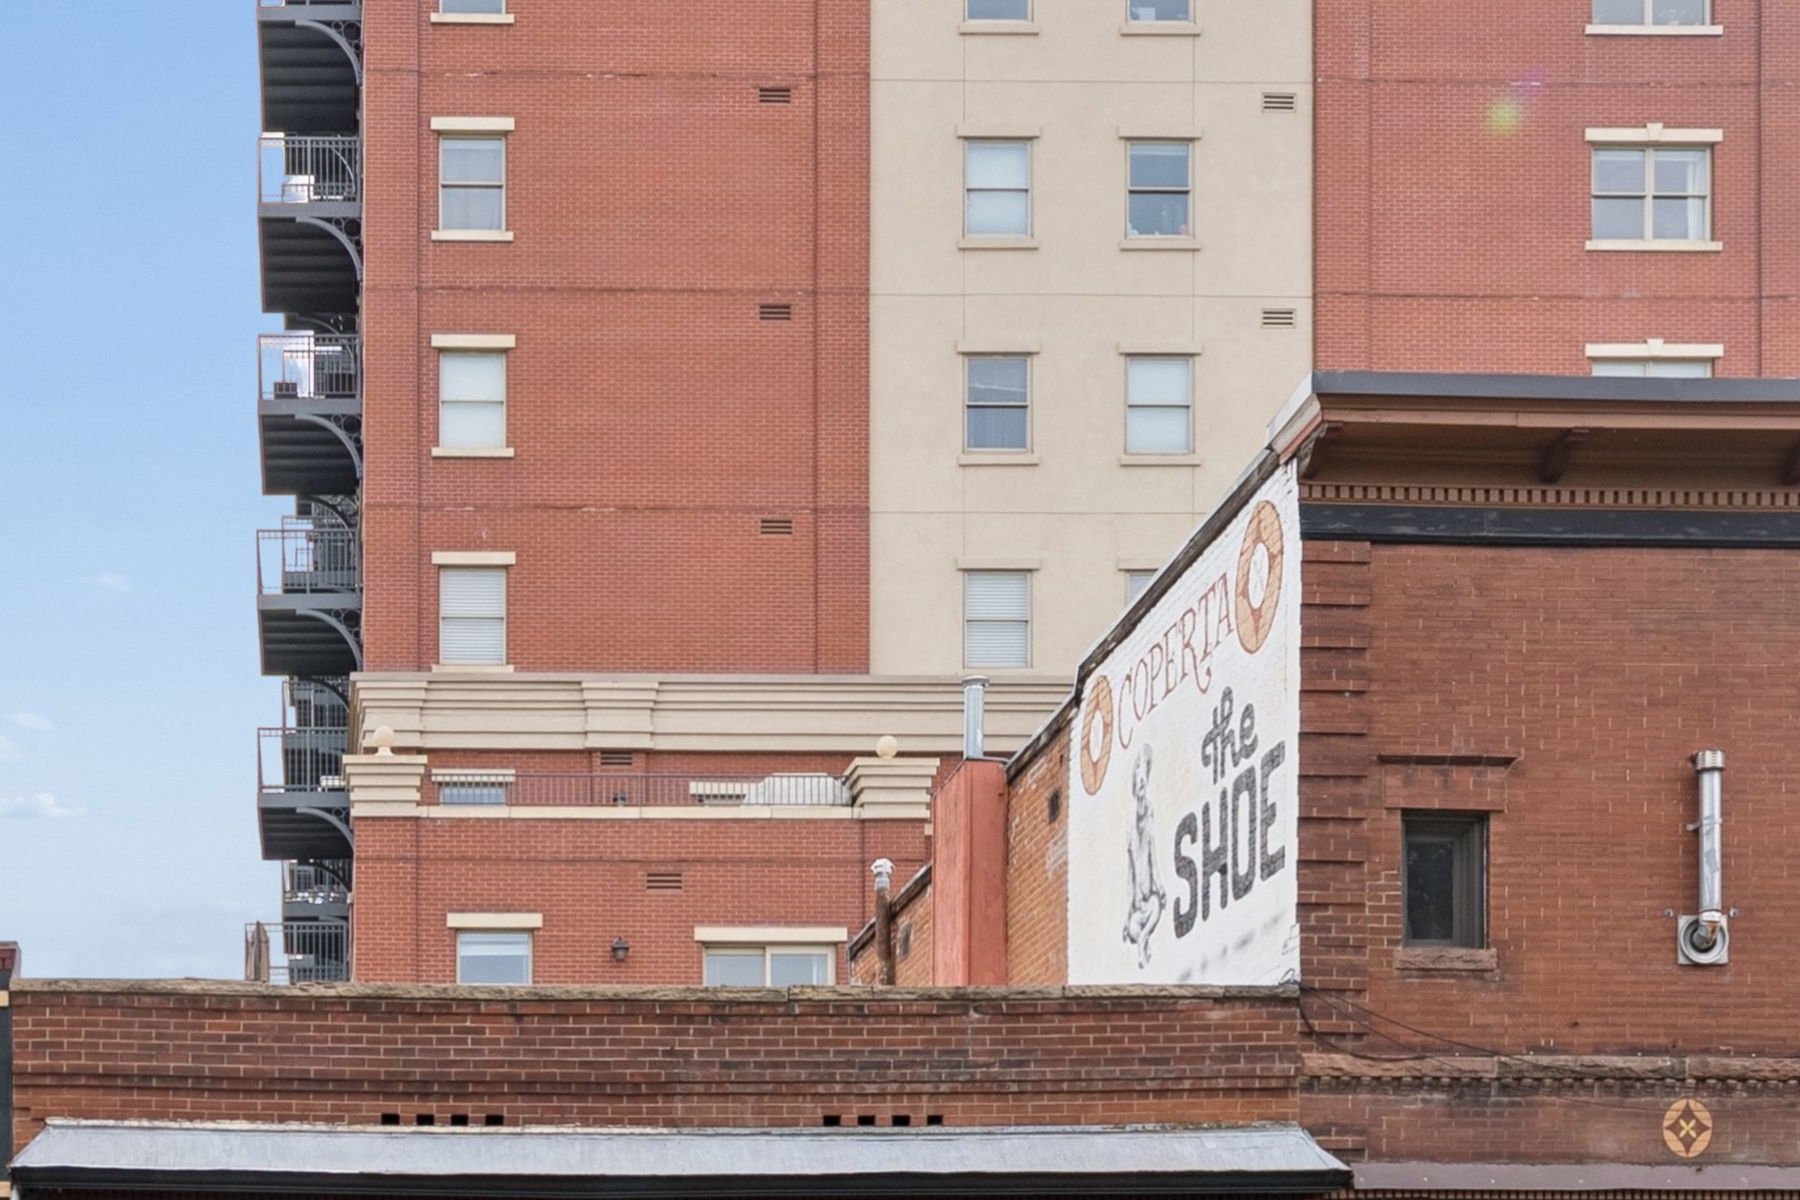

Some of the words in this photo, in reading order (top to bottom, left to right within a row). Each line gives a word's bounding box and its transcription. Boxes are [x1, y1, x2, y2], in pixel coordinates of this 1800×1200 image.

[1116, 572, 1234, 750] COPERTA
[1200, 685, 1259, 786] the
[1172, 739, 1286, 940] SHOE
